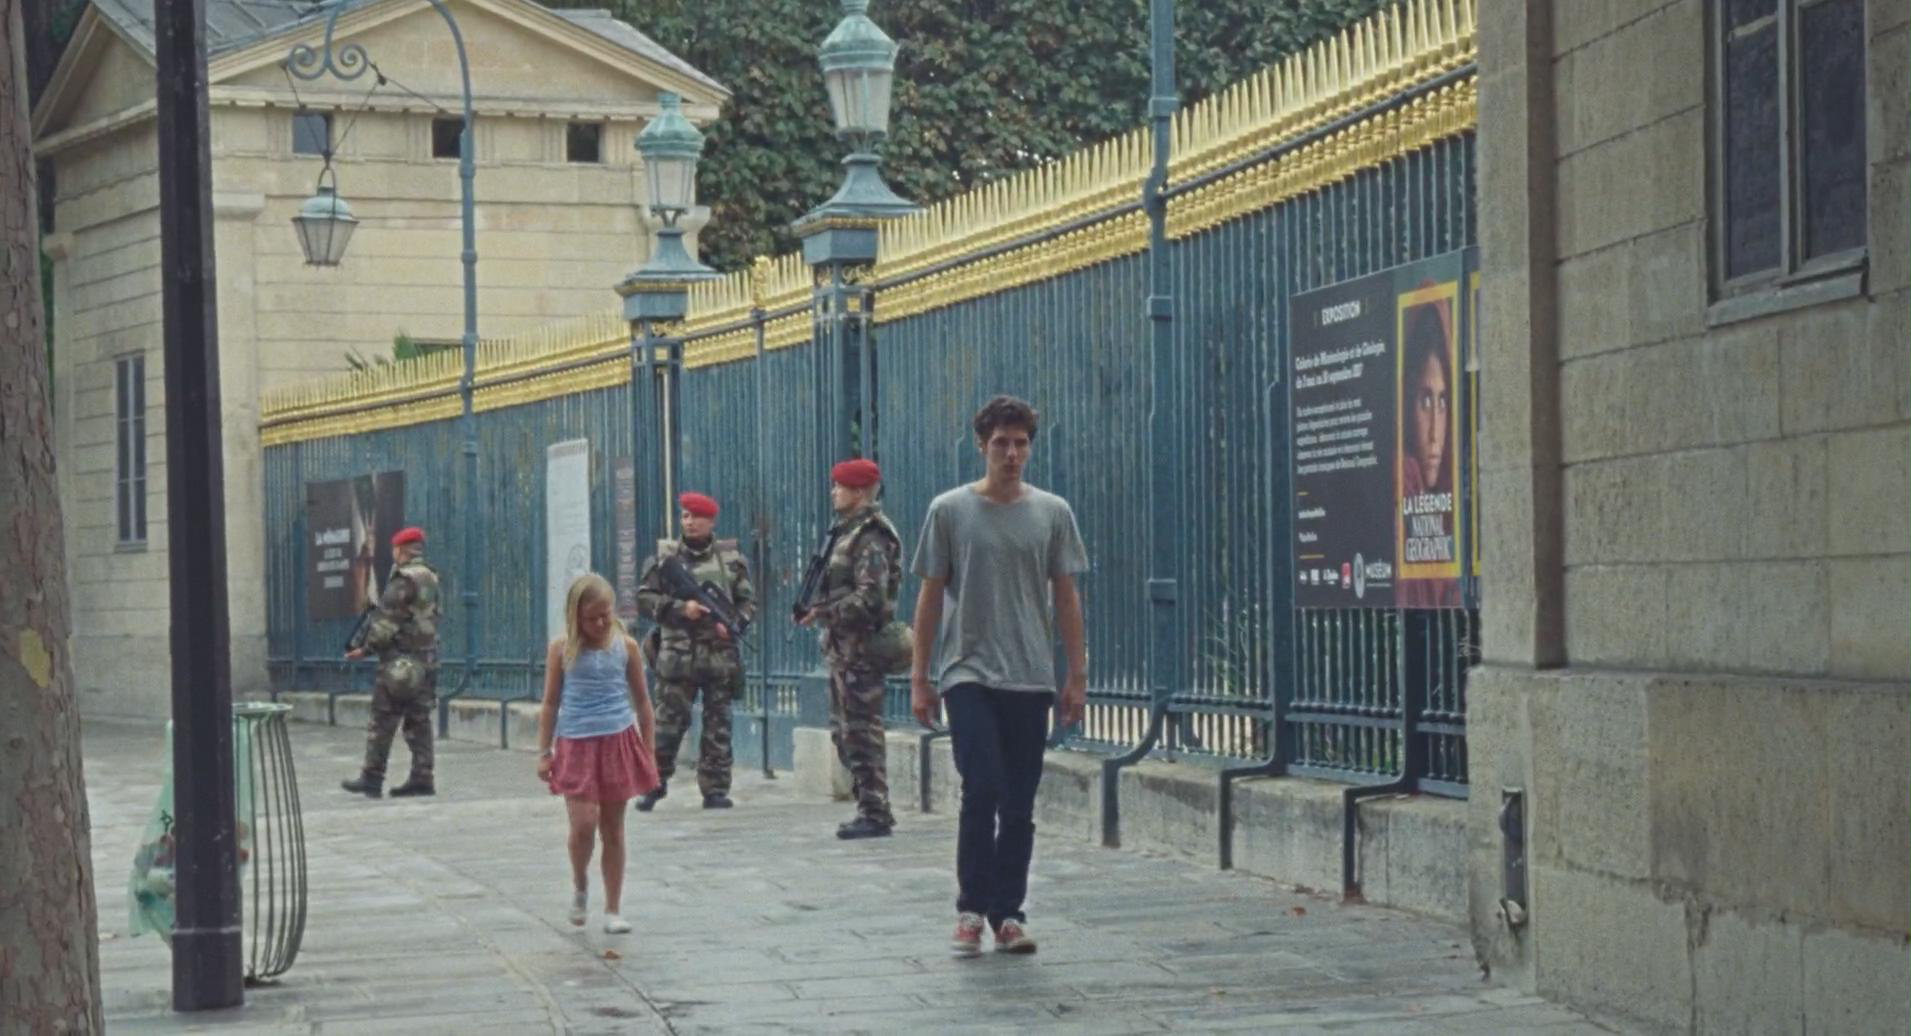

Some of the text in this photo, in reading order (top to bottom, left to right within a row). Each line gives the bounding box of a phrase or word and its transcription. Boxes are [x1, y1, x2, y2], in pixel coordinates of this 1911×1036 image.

[1321, 300, 1361, 326] EXPOSITION
[1403, 488, 1452, 515] LA LÉGENDE
[1412, 514, 1445, 537] NATIONAL
[1405, 536, 1452, 561] GEOGRAPHIC
